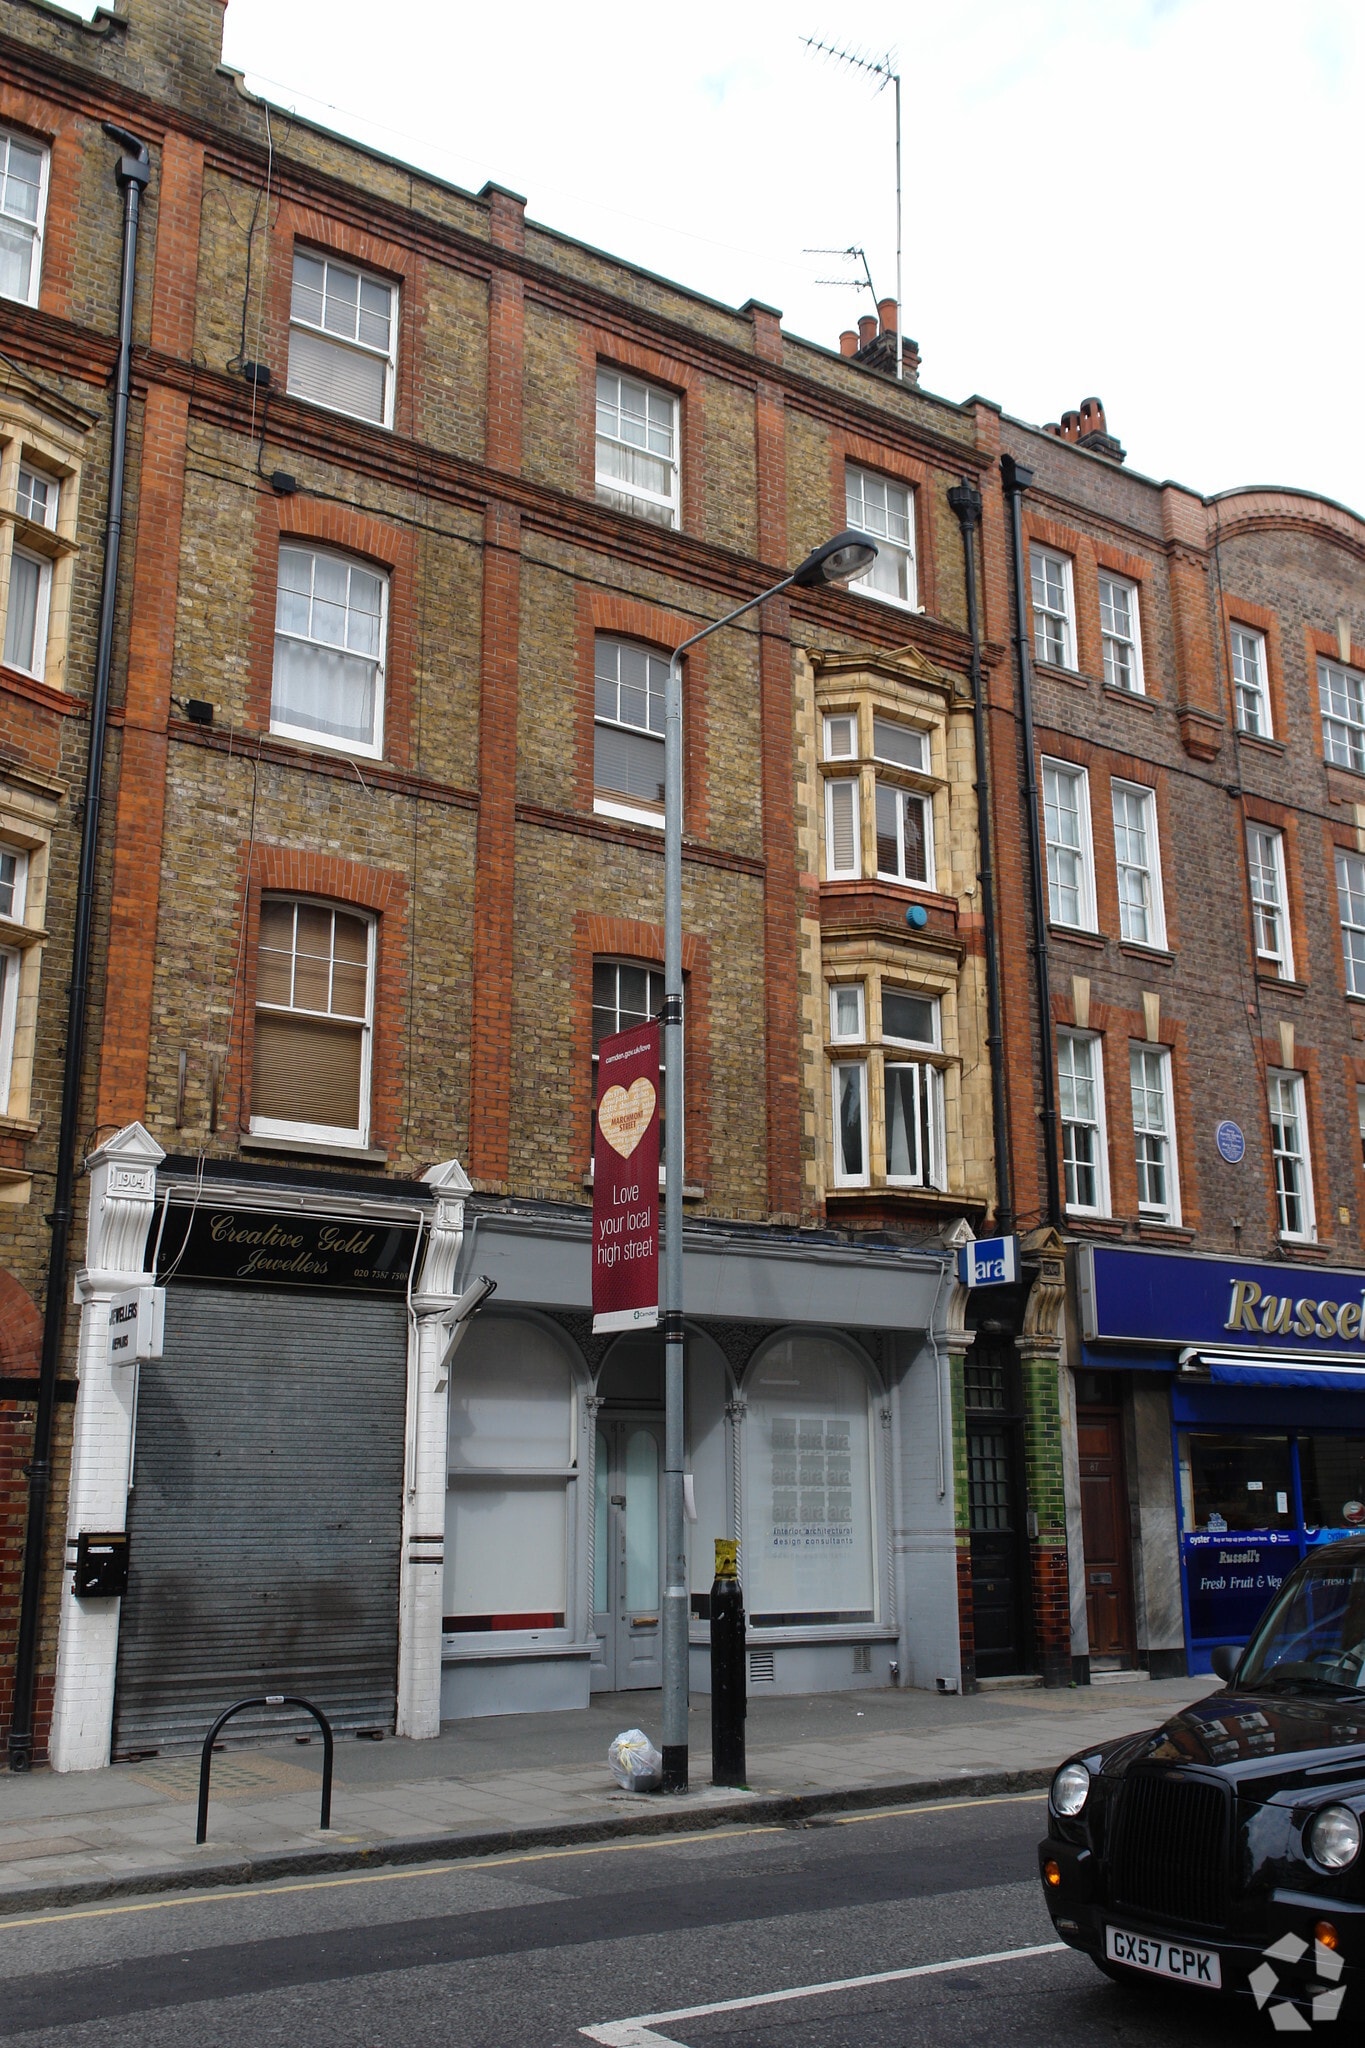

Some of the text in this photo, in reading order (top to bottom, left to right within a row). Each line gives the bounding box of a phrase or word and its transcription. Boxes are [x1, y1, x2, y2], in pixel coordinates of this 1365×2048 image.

[611, 1111, 643, 1126] MARCHMONT
[619, 1121, 636, 1132] STREET
[117, 1172, 145, 1188] 1904
[613, 1185, 639, 1205] Love
[600, 1206, 651, 1241] your local
[210, 1215, 375, 1254] Creative Gold
[598, 1236, 653, 1268] high street
[237, 1249, 329, 1276] Jewellers
[975, 1258, 1005, 1280] ara
[353, 1269, 369, 1277] 020
[805, 1527, 852, 1535] architectural
[773, 1538, 802, 1546] design
[1190, 1535, 1210, 1546] oyster
[1218, 1549, 1260, 1564] Russell's
[1200, 1575, 1283, 1590] Fresh Fruit & Veg
[1114, 1932, 1212, 1981] GX57 CPK
